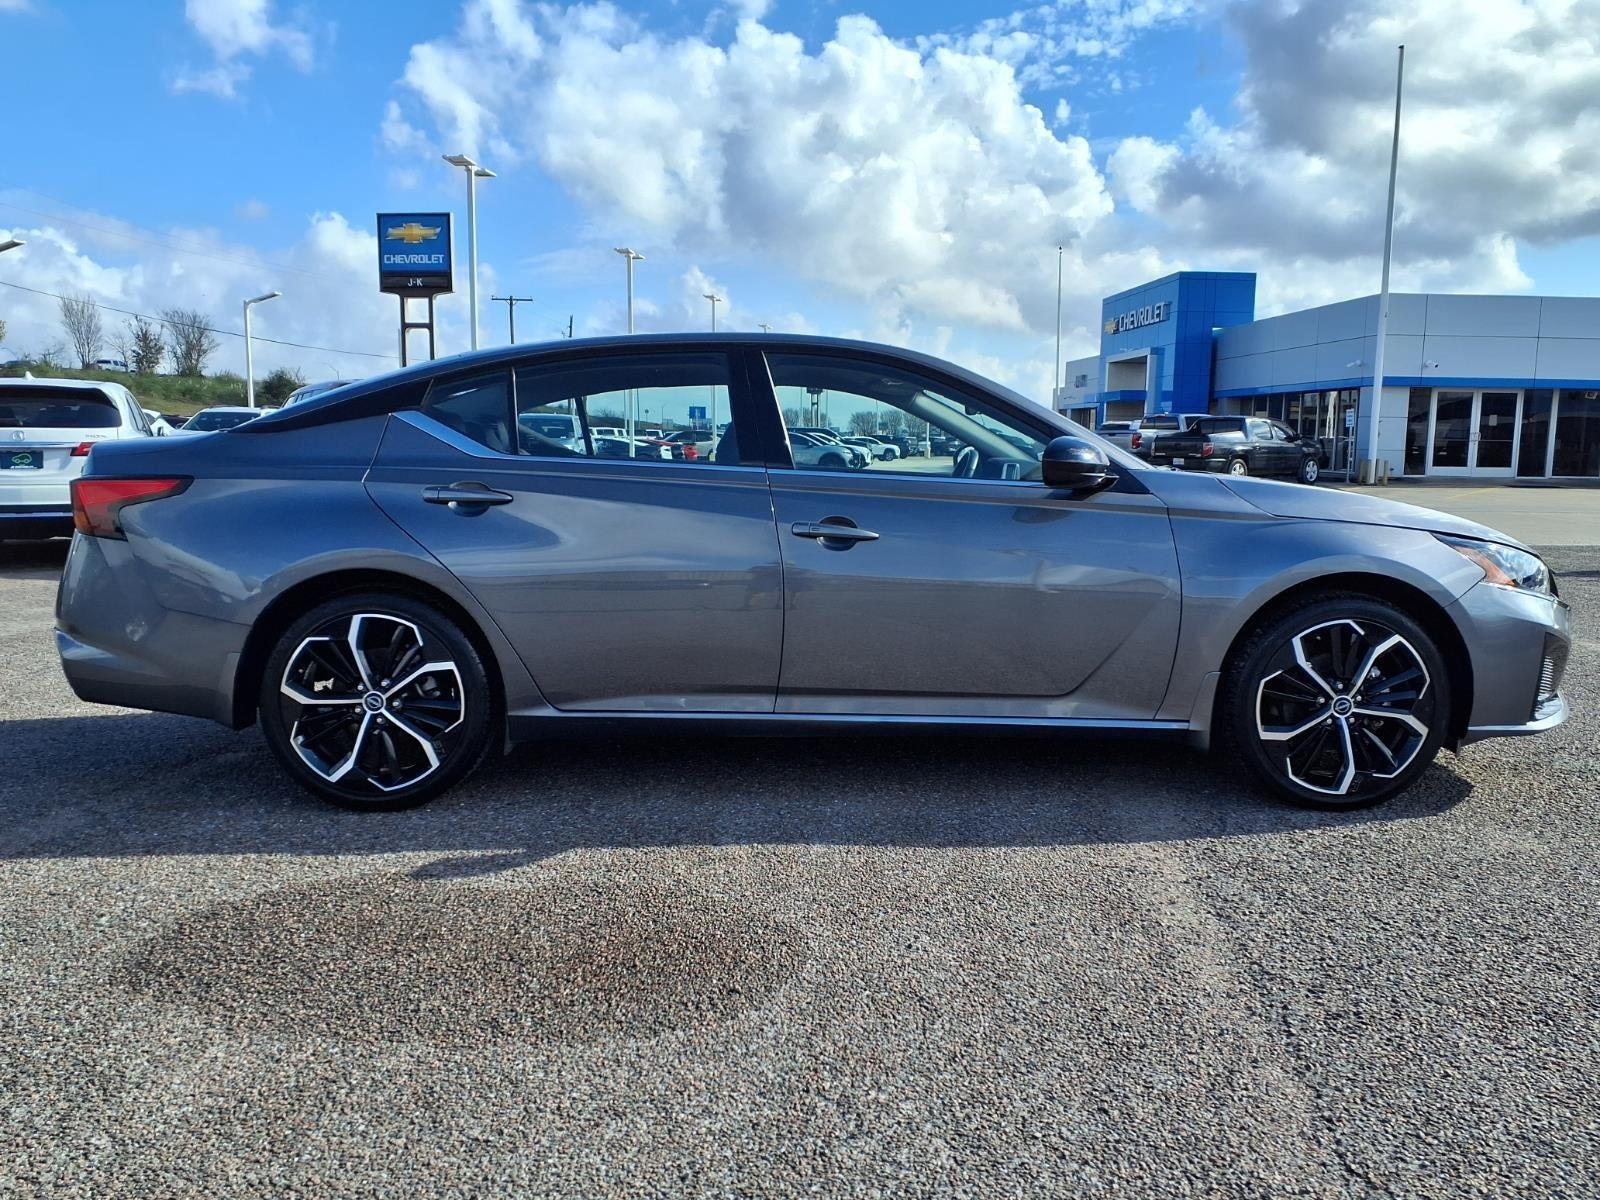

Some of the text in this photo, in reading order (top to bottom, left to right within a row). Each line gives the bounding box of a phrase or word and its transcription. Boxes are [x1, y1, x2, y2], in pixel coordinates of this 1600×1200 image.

[384, 254, 444, 264] CHEVROLET
[407, 278, 423, 287] J-K
[1119, 302, 1167, 332] CHEVROLET
